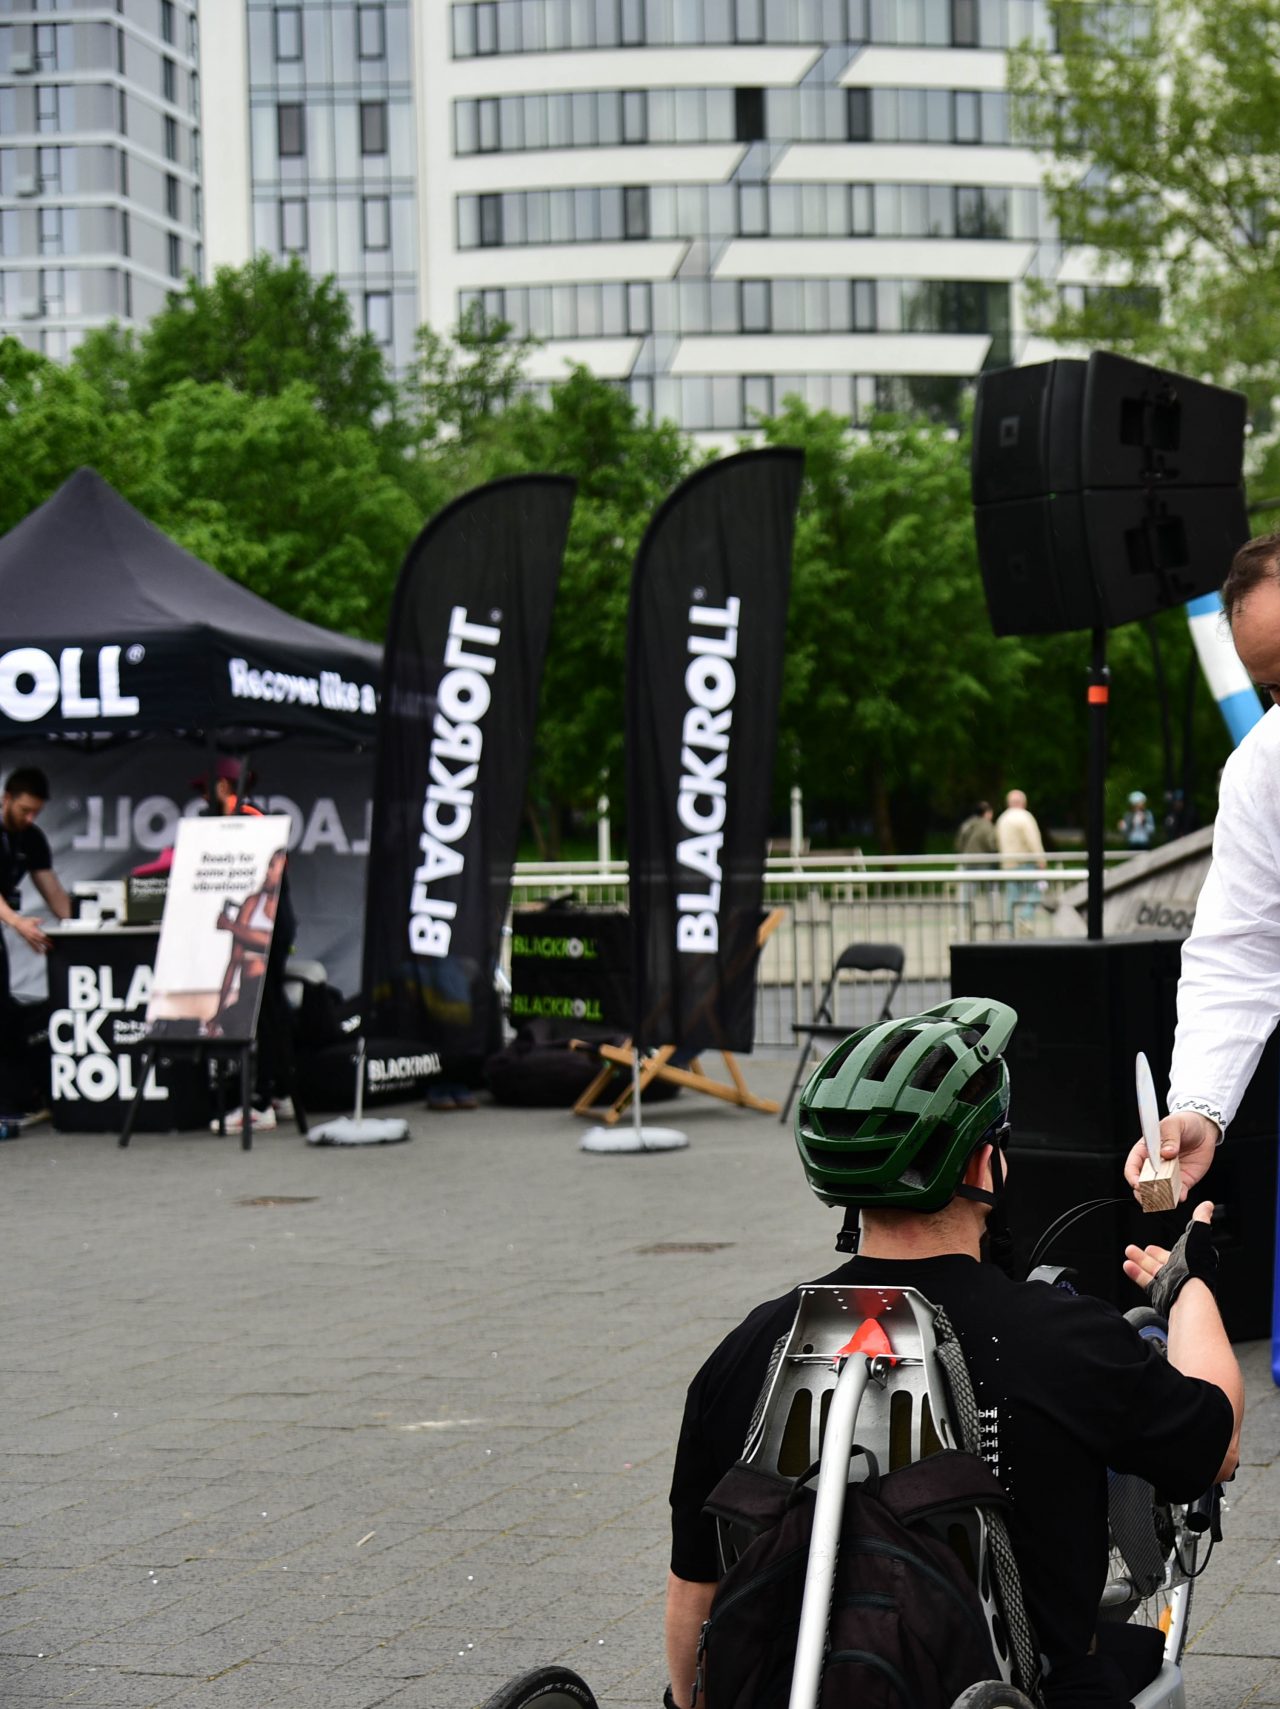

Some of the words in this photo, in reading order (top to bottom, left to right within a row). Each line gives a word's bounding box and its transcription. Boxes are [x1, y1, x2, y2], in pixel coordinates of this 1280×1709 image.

[228, 657, 320, 707] Recover
[319, 670, 360, 713] like
[360, 683, 377, 715] a
[677, 596, 741, 954] BLACKROLL
[49, 1008, 112, 1056] CK
[367, 1053, 442, 1081] BLACKROLL
